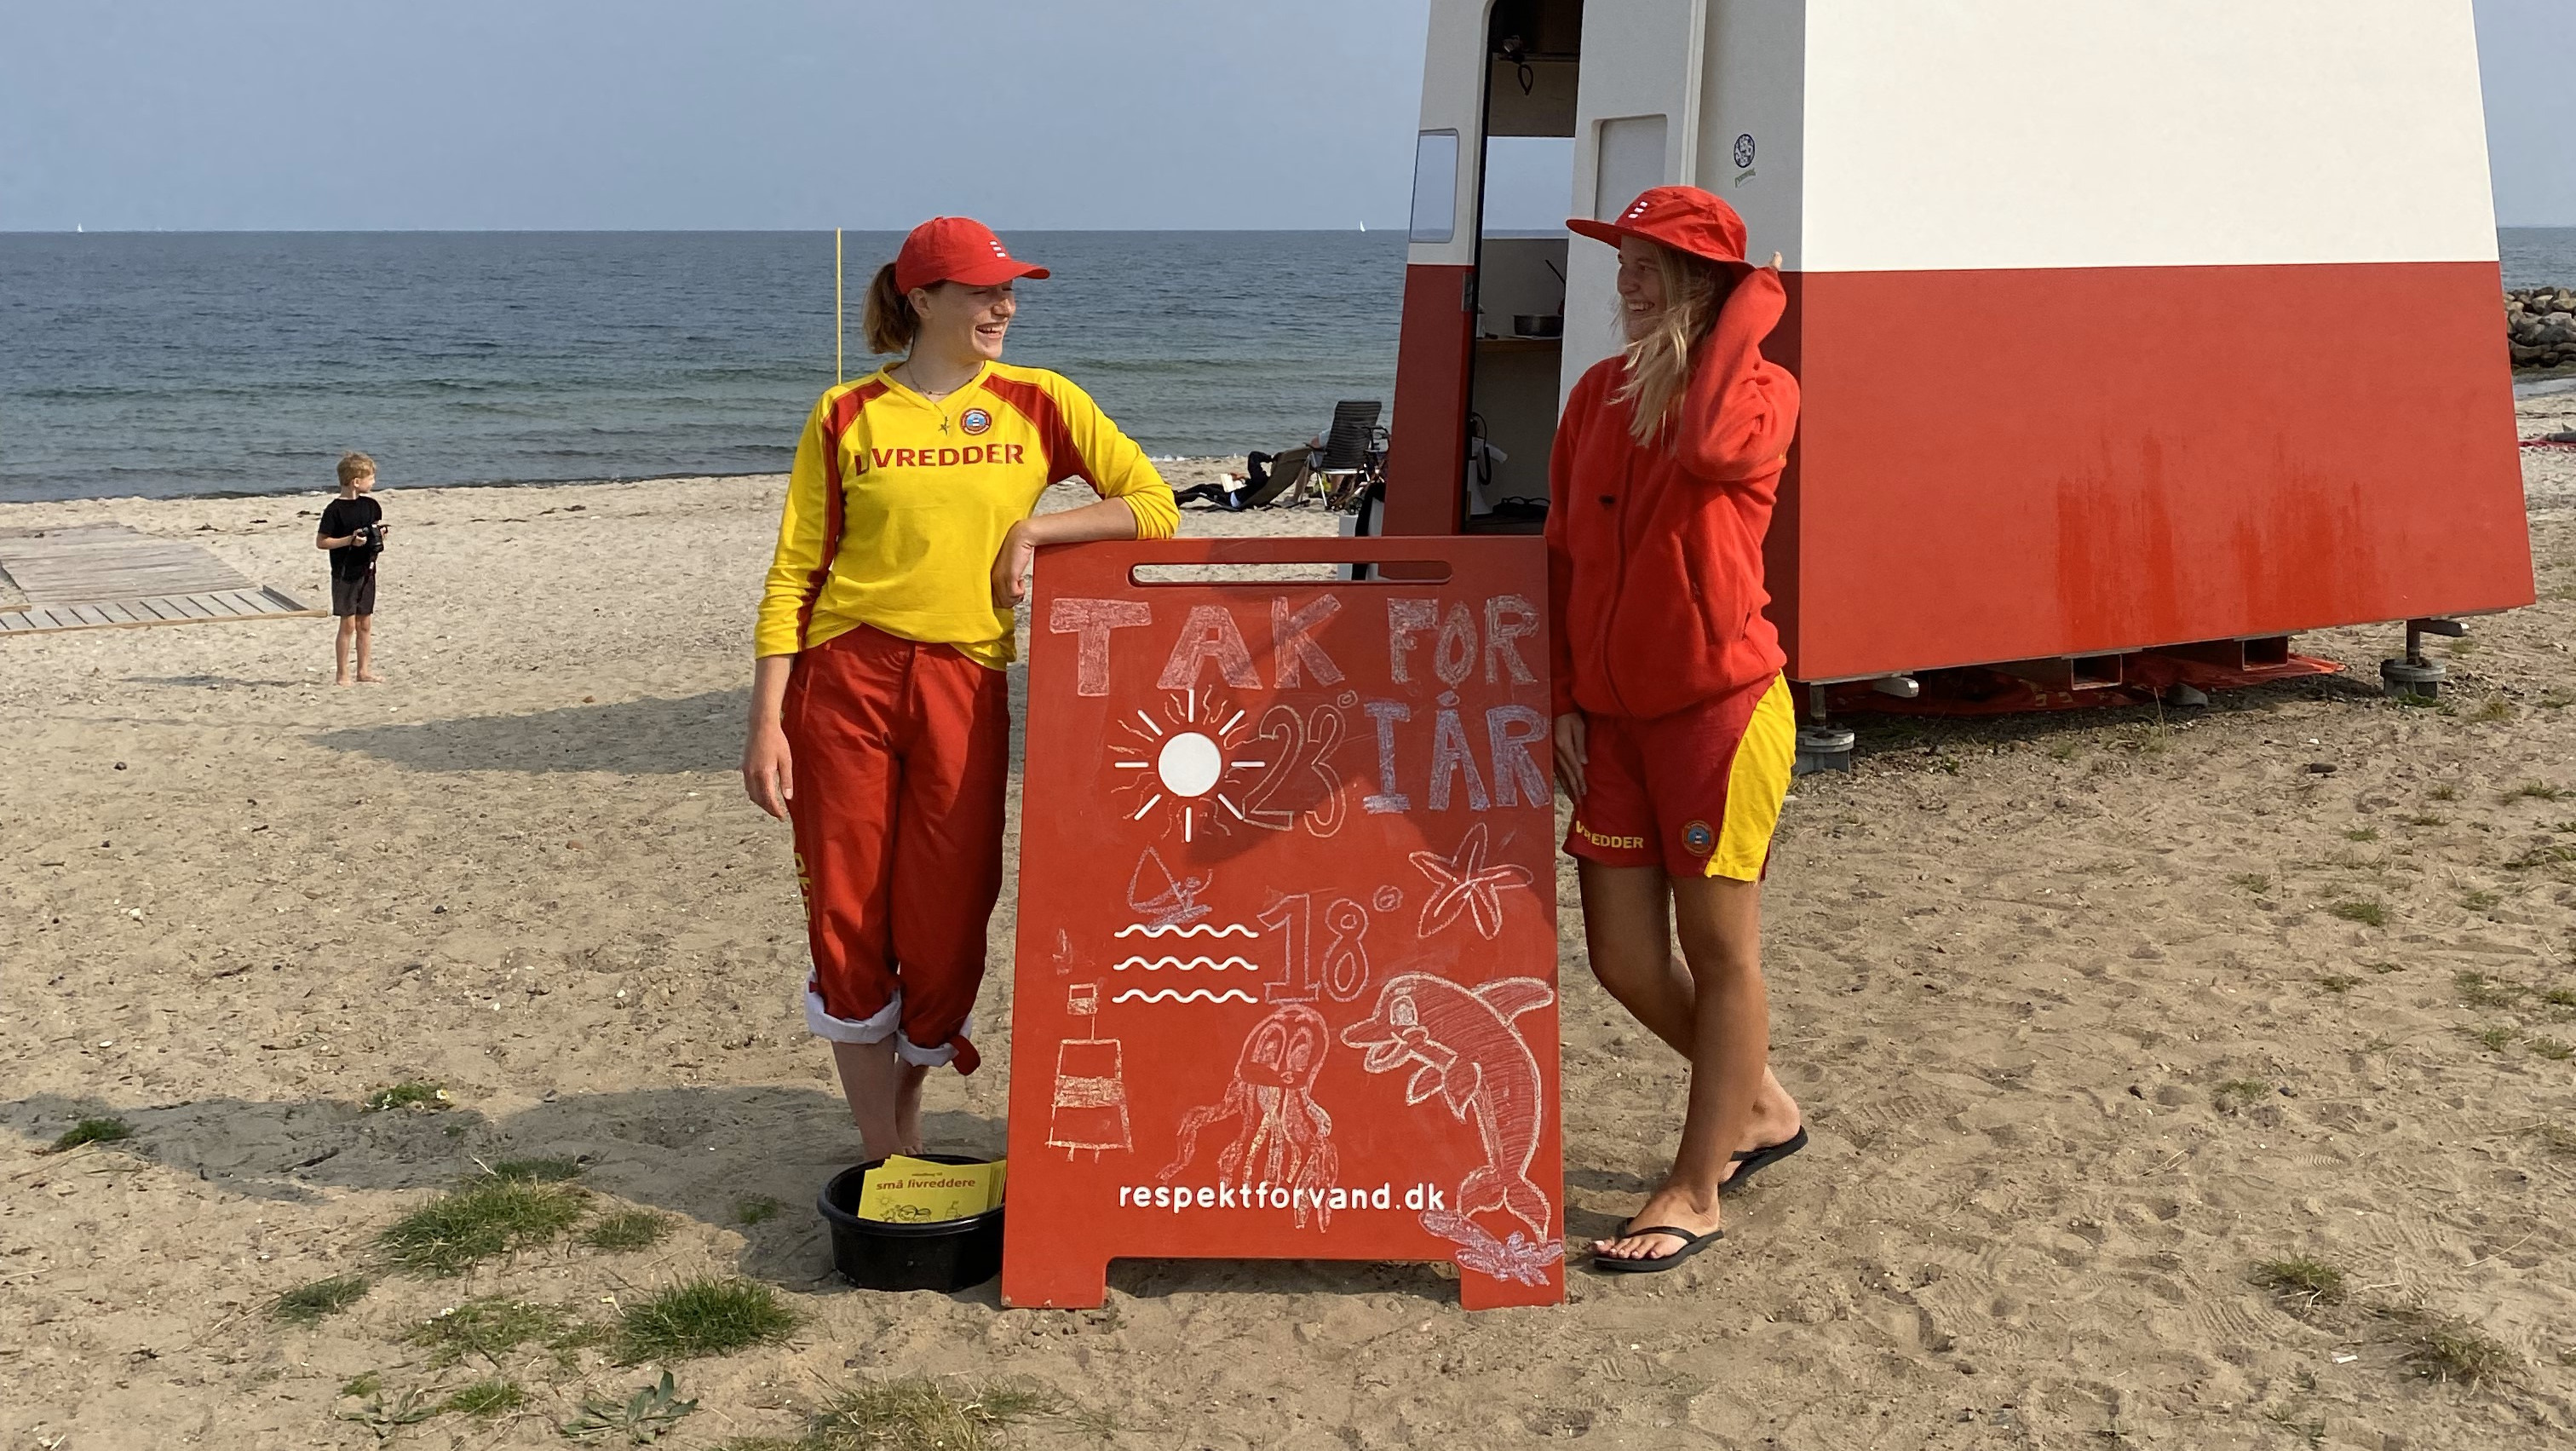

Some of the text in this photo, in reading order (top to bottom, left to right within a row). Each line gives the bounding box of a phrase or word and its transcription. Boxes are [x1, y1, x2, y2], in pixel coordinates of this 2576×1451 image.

[854, 443, 1024, 476] LVREDDER
[1049, 593, 1540, 697] TAK FOR
[1363, 689, 1550, 815] I ÅR
[876, 1177, 976, 1190] små livreddere
[1118, 1180, 1446, 1214] respektforvand.dk
